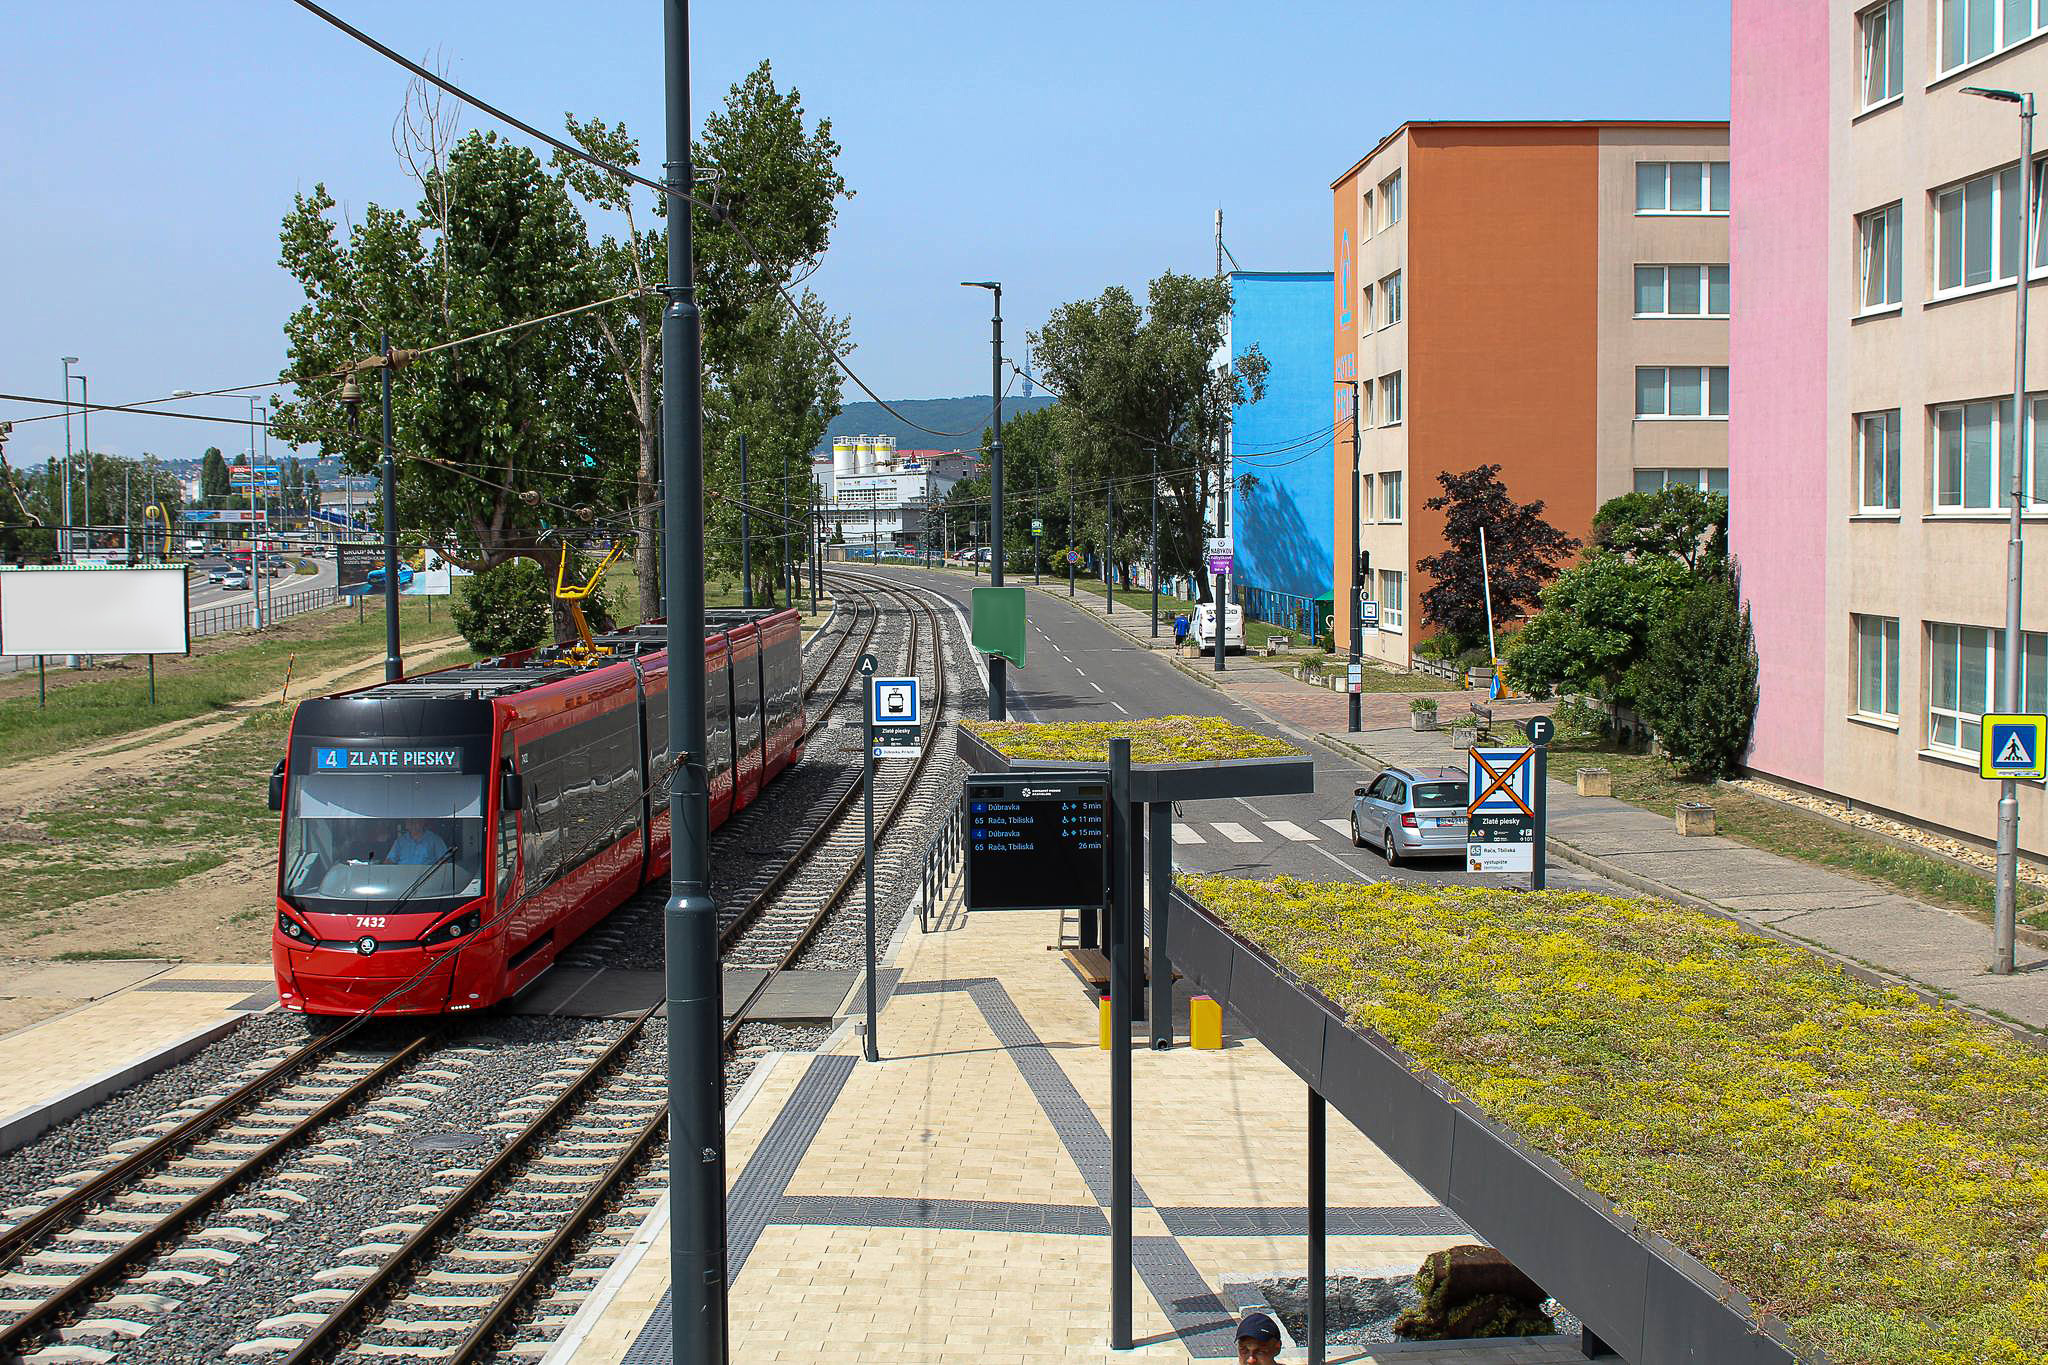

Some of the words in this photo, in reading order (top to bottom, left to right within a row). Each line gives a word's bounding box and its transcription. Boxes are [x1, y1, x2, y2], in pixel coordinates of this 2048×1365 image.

[861, 658, 873, 671] A
[1534, 722, 1546, 738] F
[326, 750, 338, 767] 4
[350, 749, 398, 766] ZLATÉ
[403, 751, 456, 766] PIESKY
[988, 803, 1020, 811] Dúbravka
[988, 817, 1007, 825] Rača,
[1008, 816, 1034, 824] Tbiliská
[1499, 818, 1520, 826] piesky
[988, 830, 1020, 838] Dúbravka
[988, 843, 1007, 852] Rača,
[1471, 846, 1481, 854] 65
[356, 916, 386, 928] 7432
